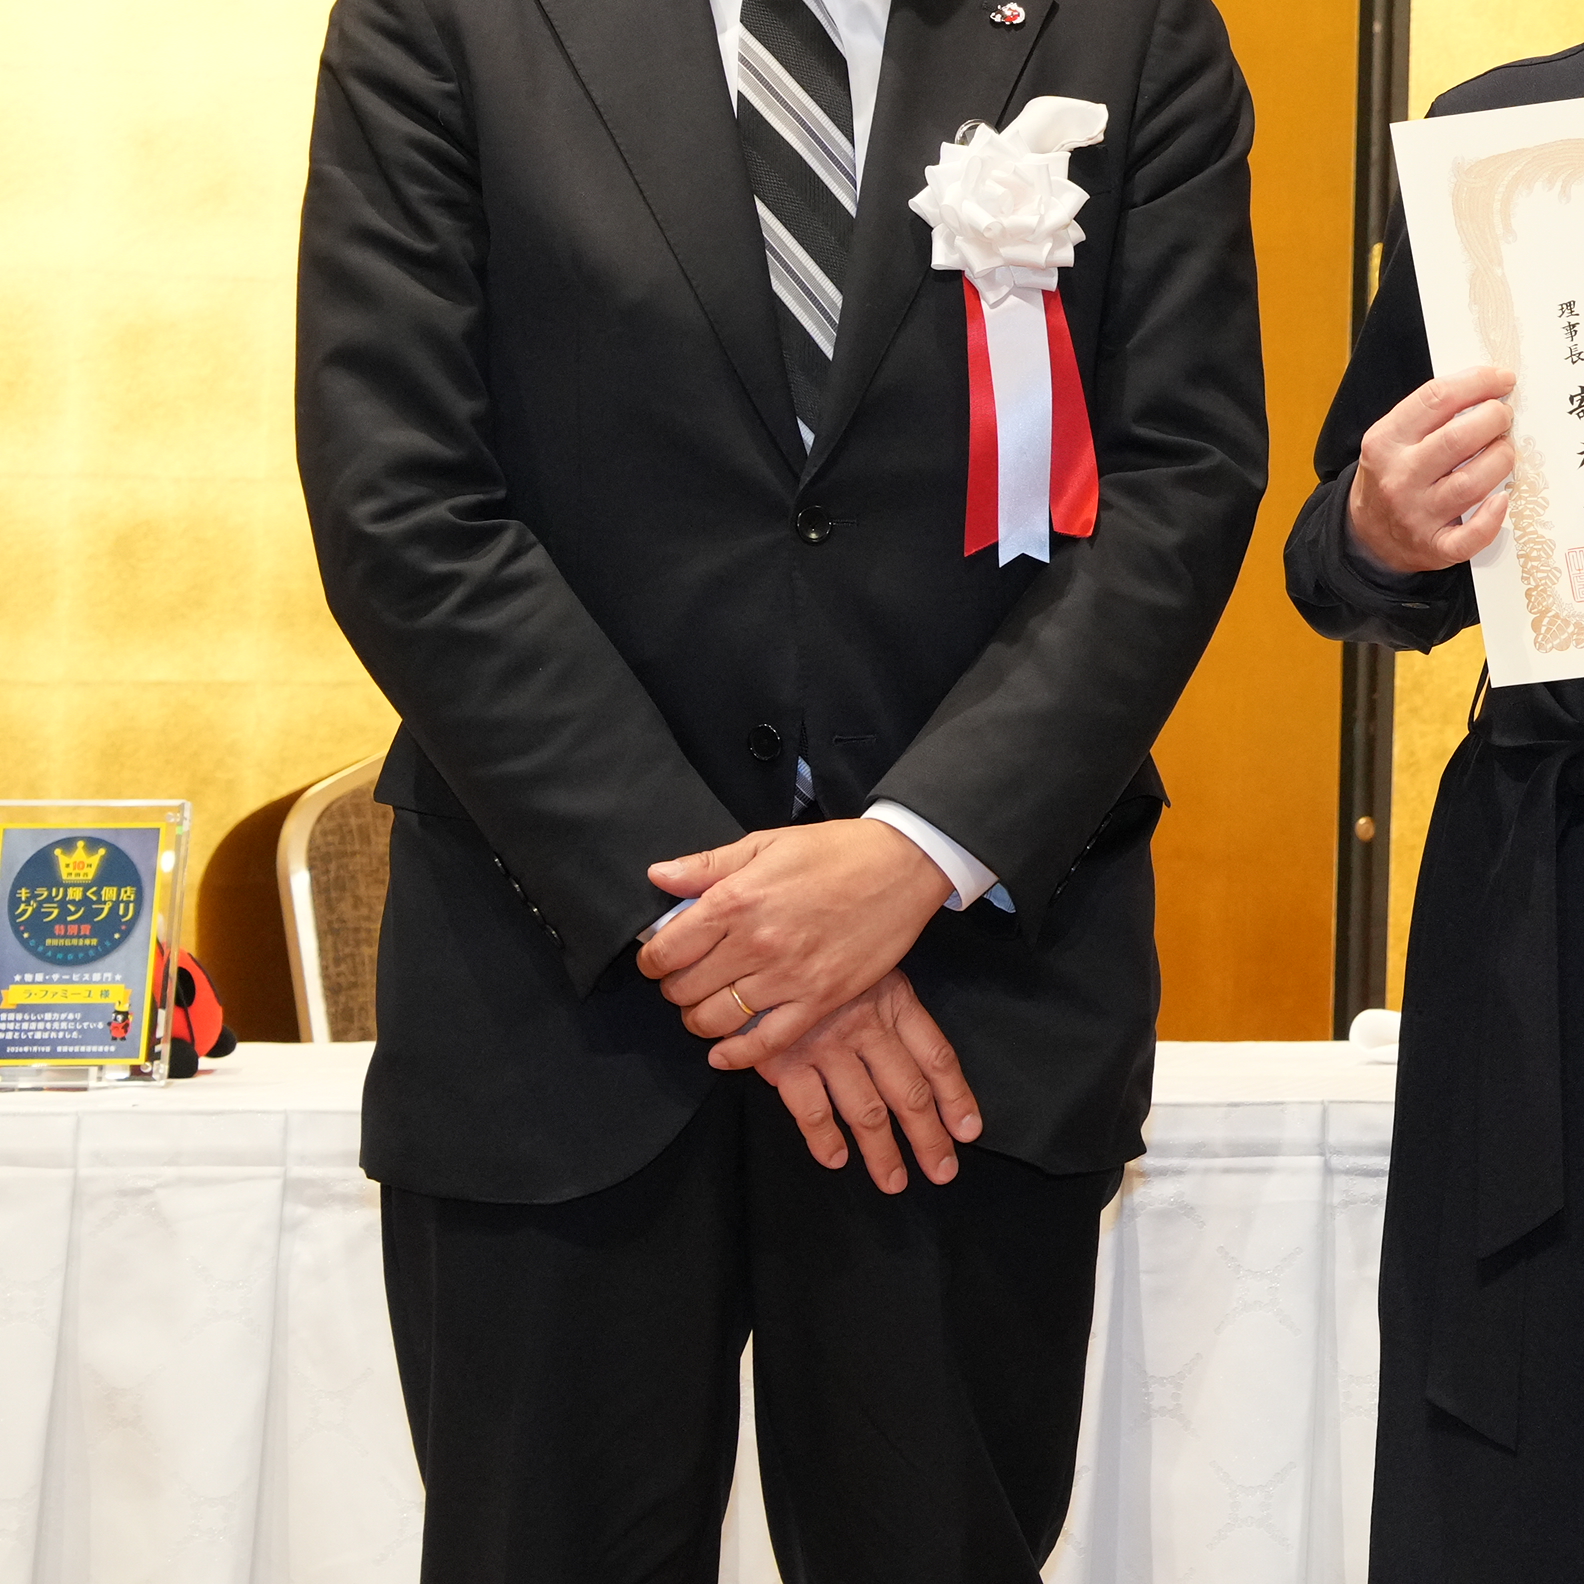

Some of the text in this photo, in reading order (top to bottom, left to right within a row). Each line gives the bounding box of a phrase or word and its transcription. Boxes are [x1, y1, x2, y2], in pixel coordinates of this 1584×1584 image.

[15, 885, 137, 902] キラリ輝く個店
[14, 899, 135, 922] グランプリ
[54, 923, 92, 936] 特別賞
[99, 989, 111, 999] 様
